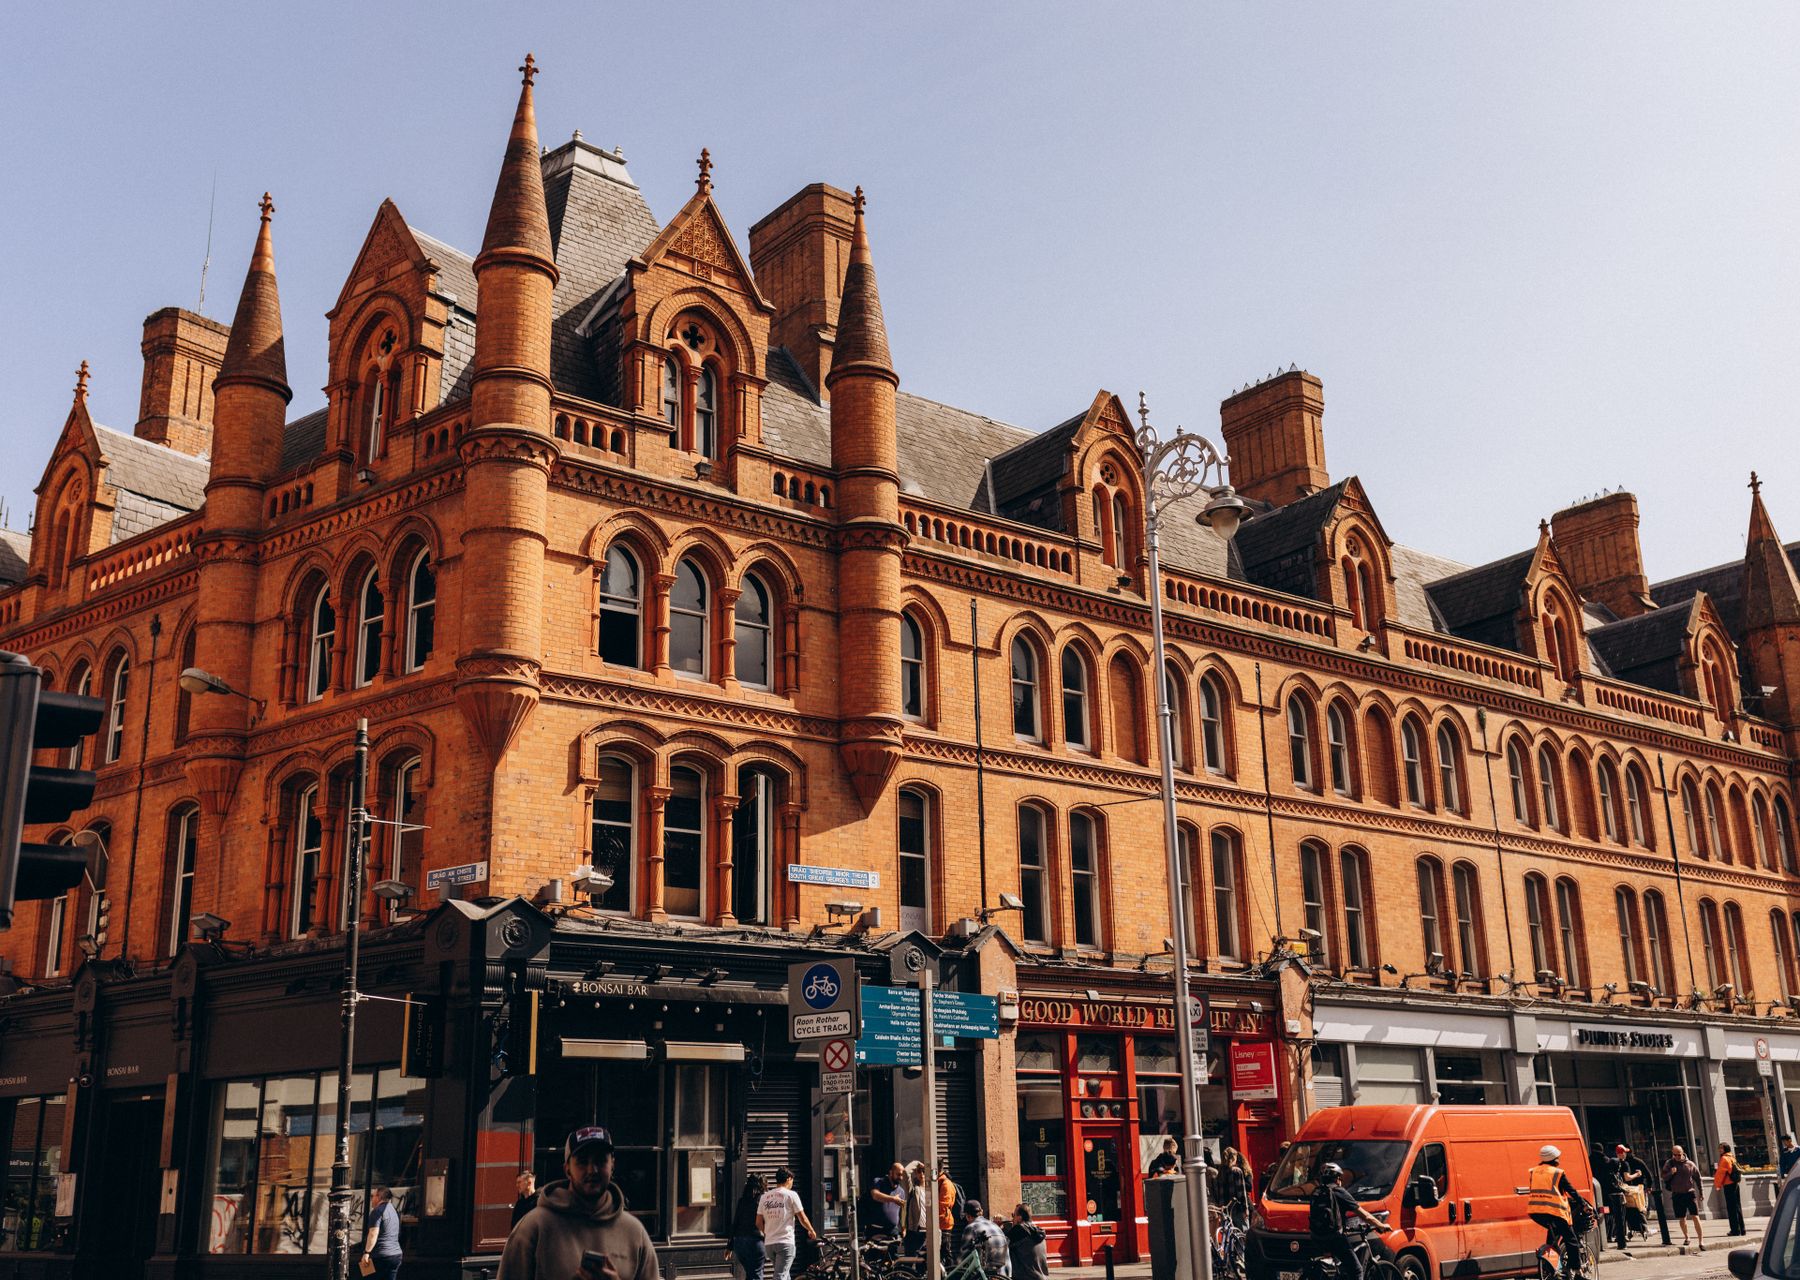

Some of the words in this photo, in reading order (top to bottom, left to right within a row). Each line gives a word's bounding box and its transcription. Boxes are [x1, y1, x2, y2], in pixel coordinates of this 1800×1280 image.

[479, 866, 484, 876] 2
[457, 874, 475, 882] STREET
[582, 983, 623, 994] BONSAI
[627, 985, 648, 996] BAR
[1021, 1000, 1073, 1023] GOOD
[1082, 1004, 1148, 1025] WORLD
[1156, 1008, 1265, 1031] RURANT
[1190, 1009, 1201, 1017] AXI
[816, 1015, 839, 1025] Rothar
[796, 1025, 821, 1035] CYCLE
[823, 1023, 849, 1034] TRACK
[1578, 1029, 1628, 1046] DUNES
[1629, 1031, 1674, 1048] STORES
[1234, 1051, 1255, 1060] Lisney
[127, 1065, 139, 1074] BAR
